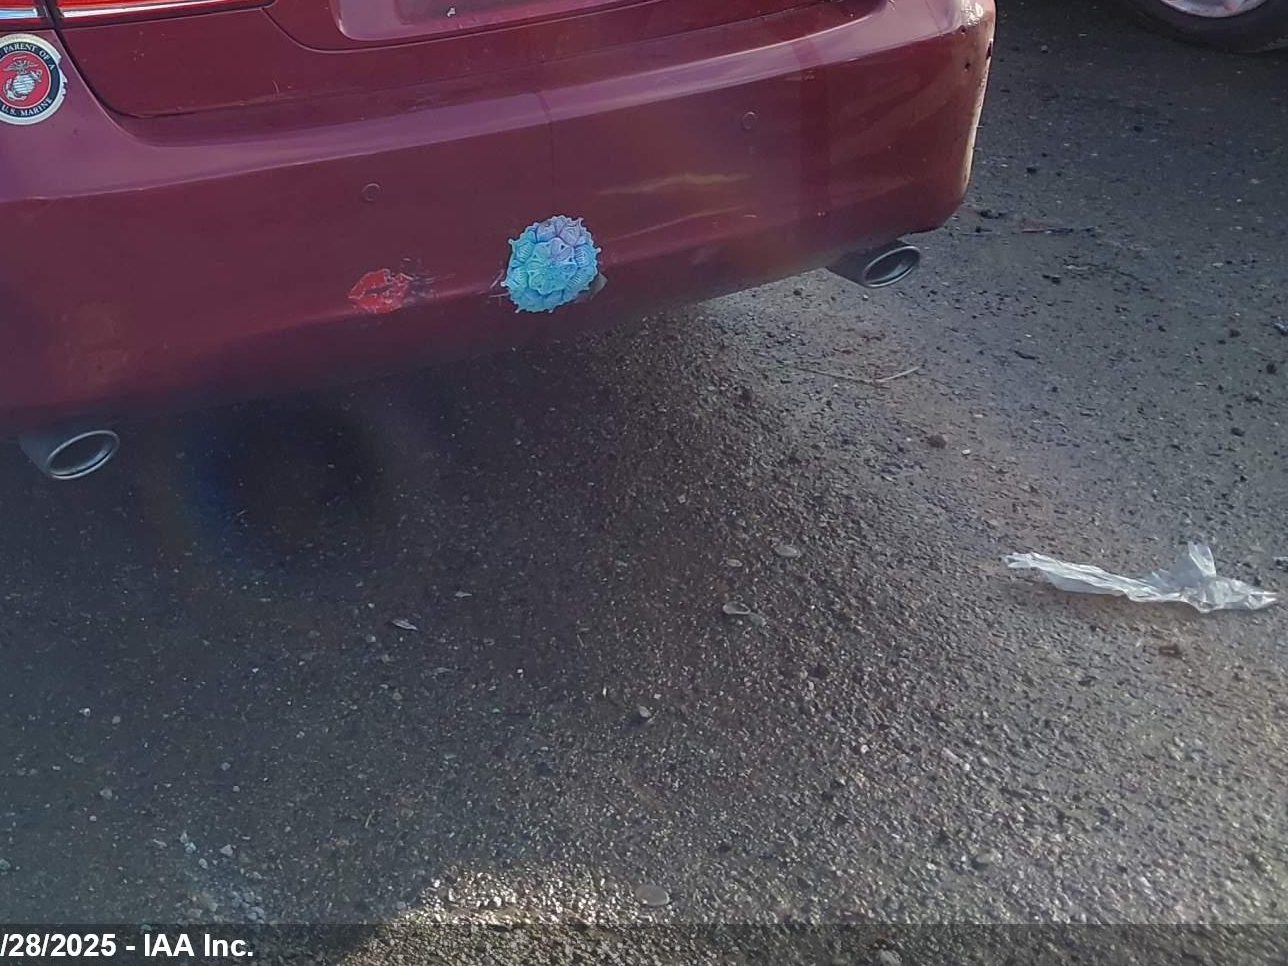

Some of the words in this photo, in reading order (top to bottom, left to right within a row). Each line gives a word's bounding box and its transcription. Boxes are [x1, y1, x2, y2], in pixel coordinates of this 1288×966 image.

[3, 43, 37, 54] PARENT
[39, 50, 50, 61] OF
[20, 97, 53, 116] MARINE
